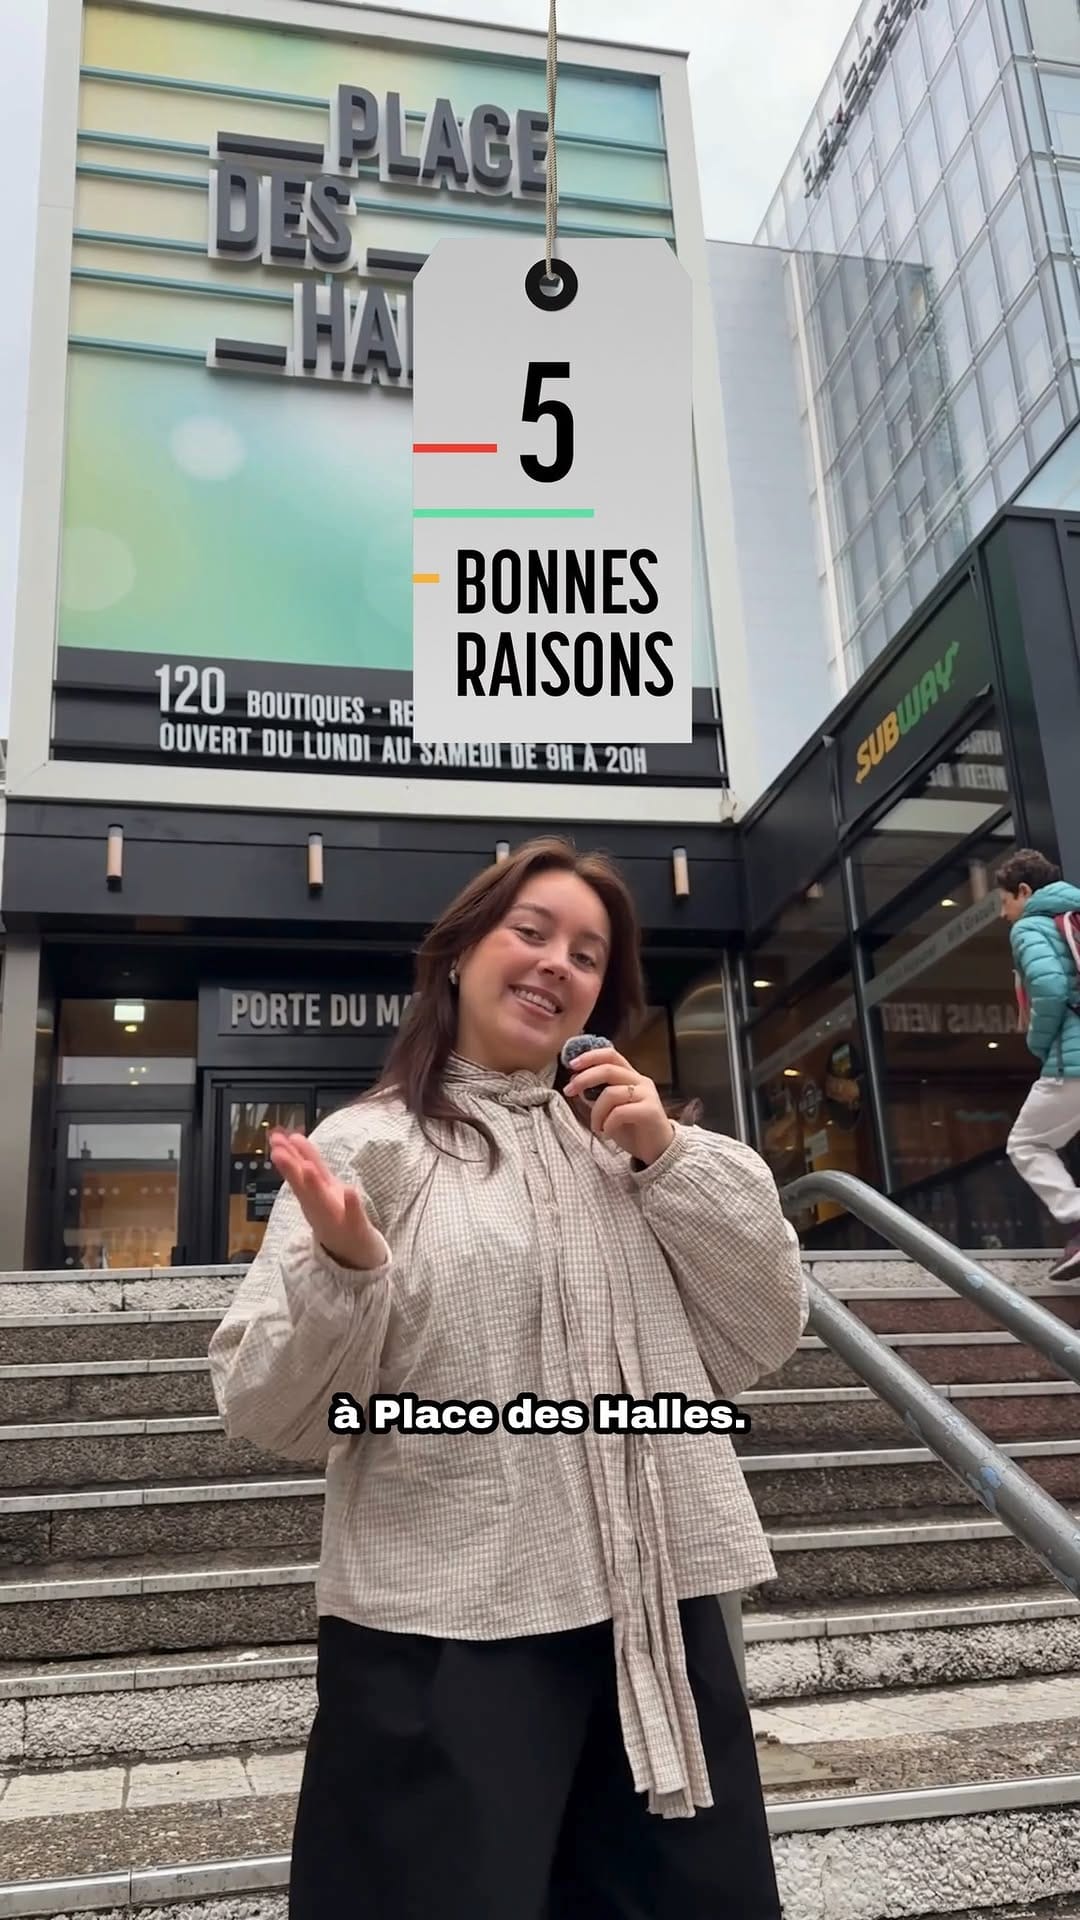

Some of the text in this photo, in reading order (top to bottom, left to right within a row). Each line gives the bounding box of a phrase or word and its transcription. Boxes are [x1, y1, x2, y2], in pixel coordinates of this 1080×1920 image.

[338, 84, 549, 192] PLACE
[216, 163, 352, 264] DES
[302, 281, 413, 380] HA
[154, 663, 226, 715] 120
[246, 689, 366, 727] BOUTIQUES
[855, 640, 960, 785] SUBWAY
[158, 721, 252, 756] OUVERT
[262, 728, 293, 758] DU
[303, 730, 371, 763] LUNDI
[381, 735, 411, 765] AU
[419, 742, 501, 770] SAMEDI
[510, 743, 538, 770] DE
[546, 743, 575, 772] 9H
[604, 745, 648, 775] 20H
[231, 992, 321, 1028] PORTE
[331, 993, 367, 1028] DU
